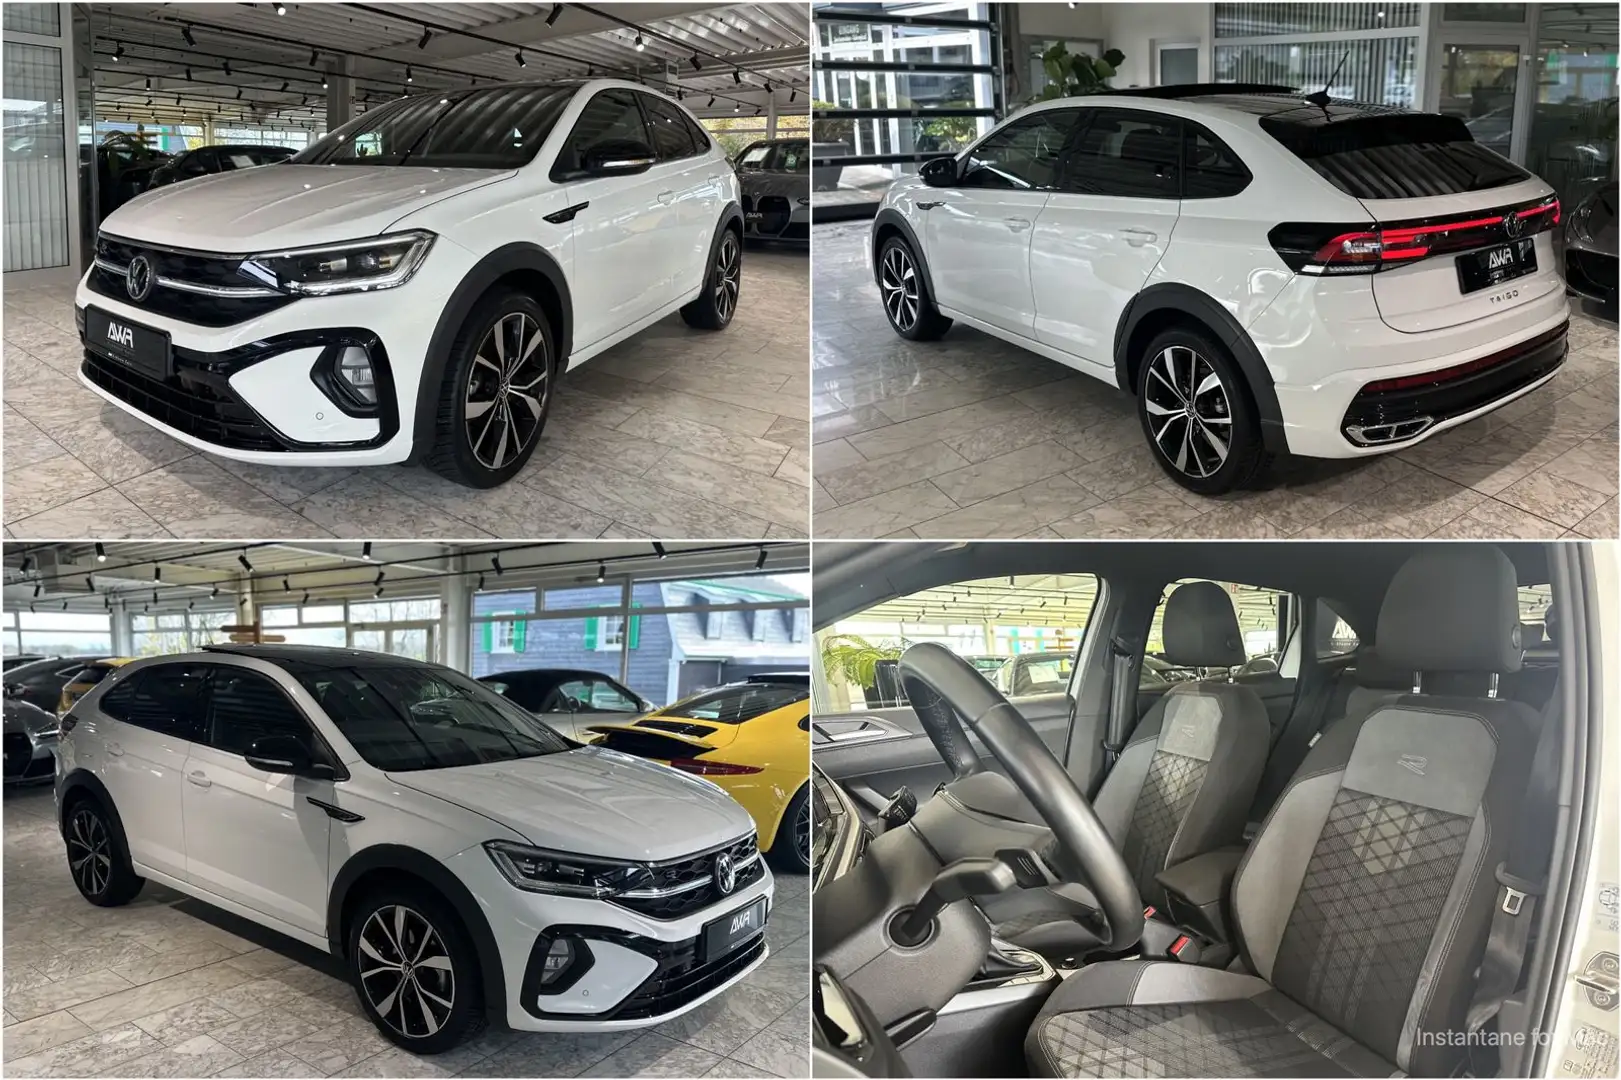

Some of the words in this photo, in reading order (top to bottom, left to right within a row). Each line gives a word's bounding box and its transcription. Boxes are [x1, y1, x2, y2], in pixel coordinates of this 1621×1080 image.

[1488, 247, 1514, 269] AWR
[1489, 289, 1519, 304] TAIGO
[107, 321, 134, 348] AWR
[729, 911, 751, 935] AWR
